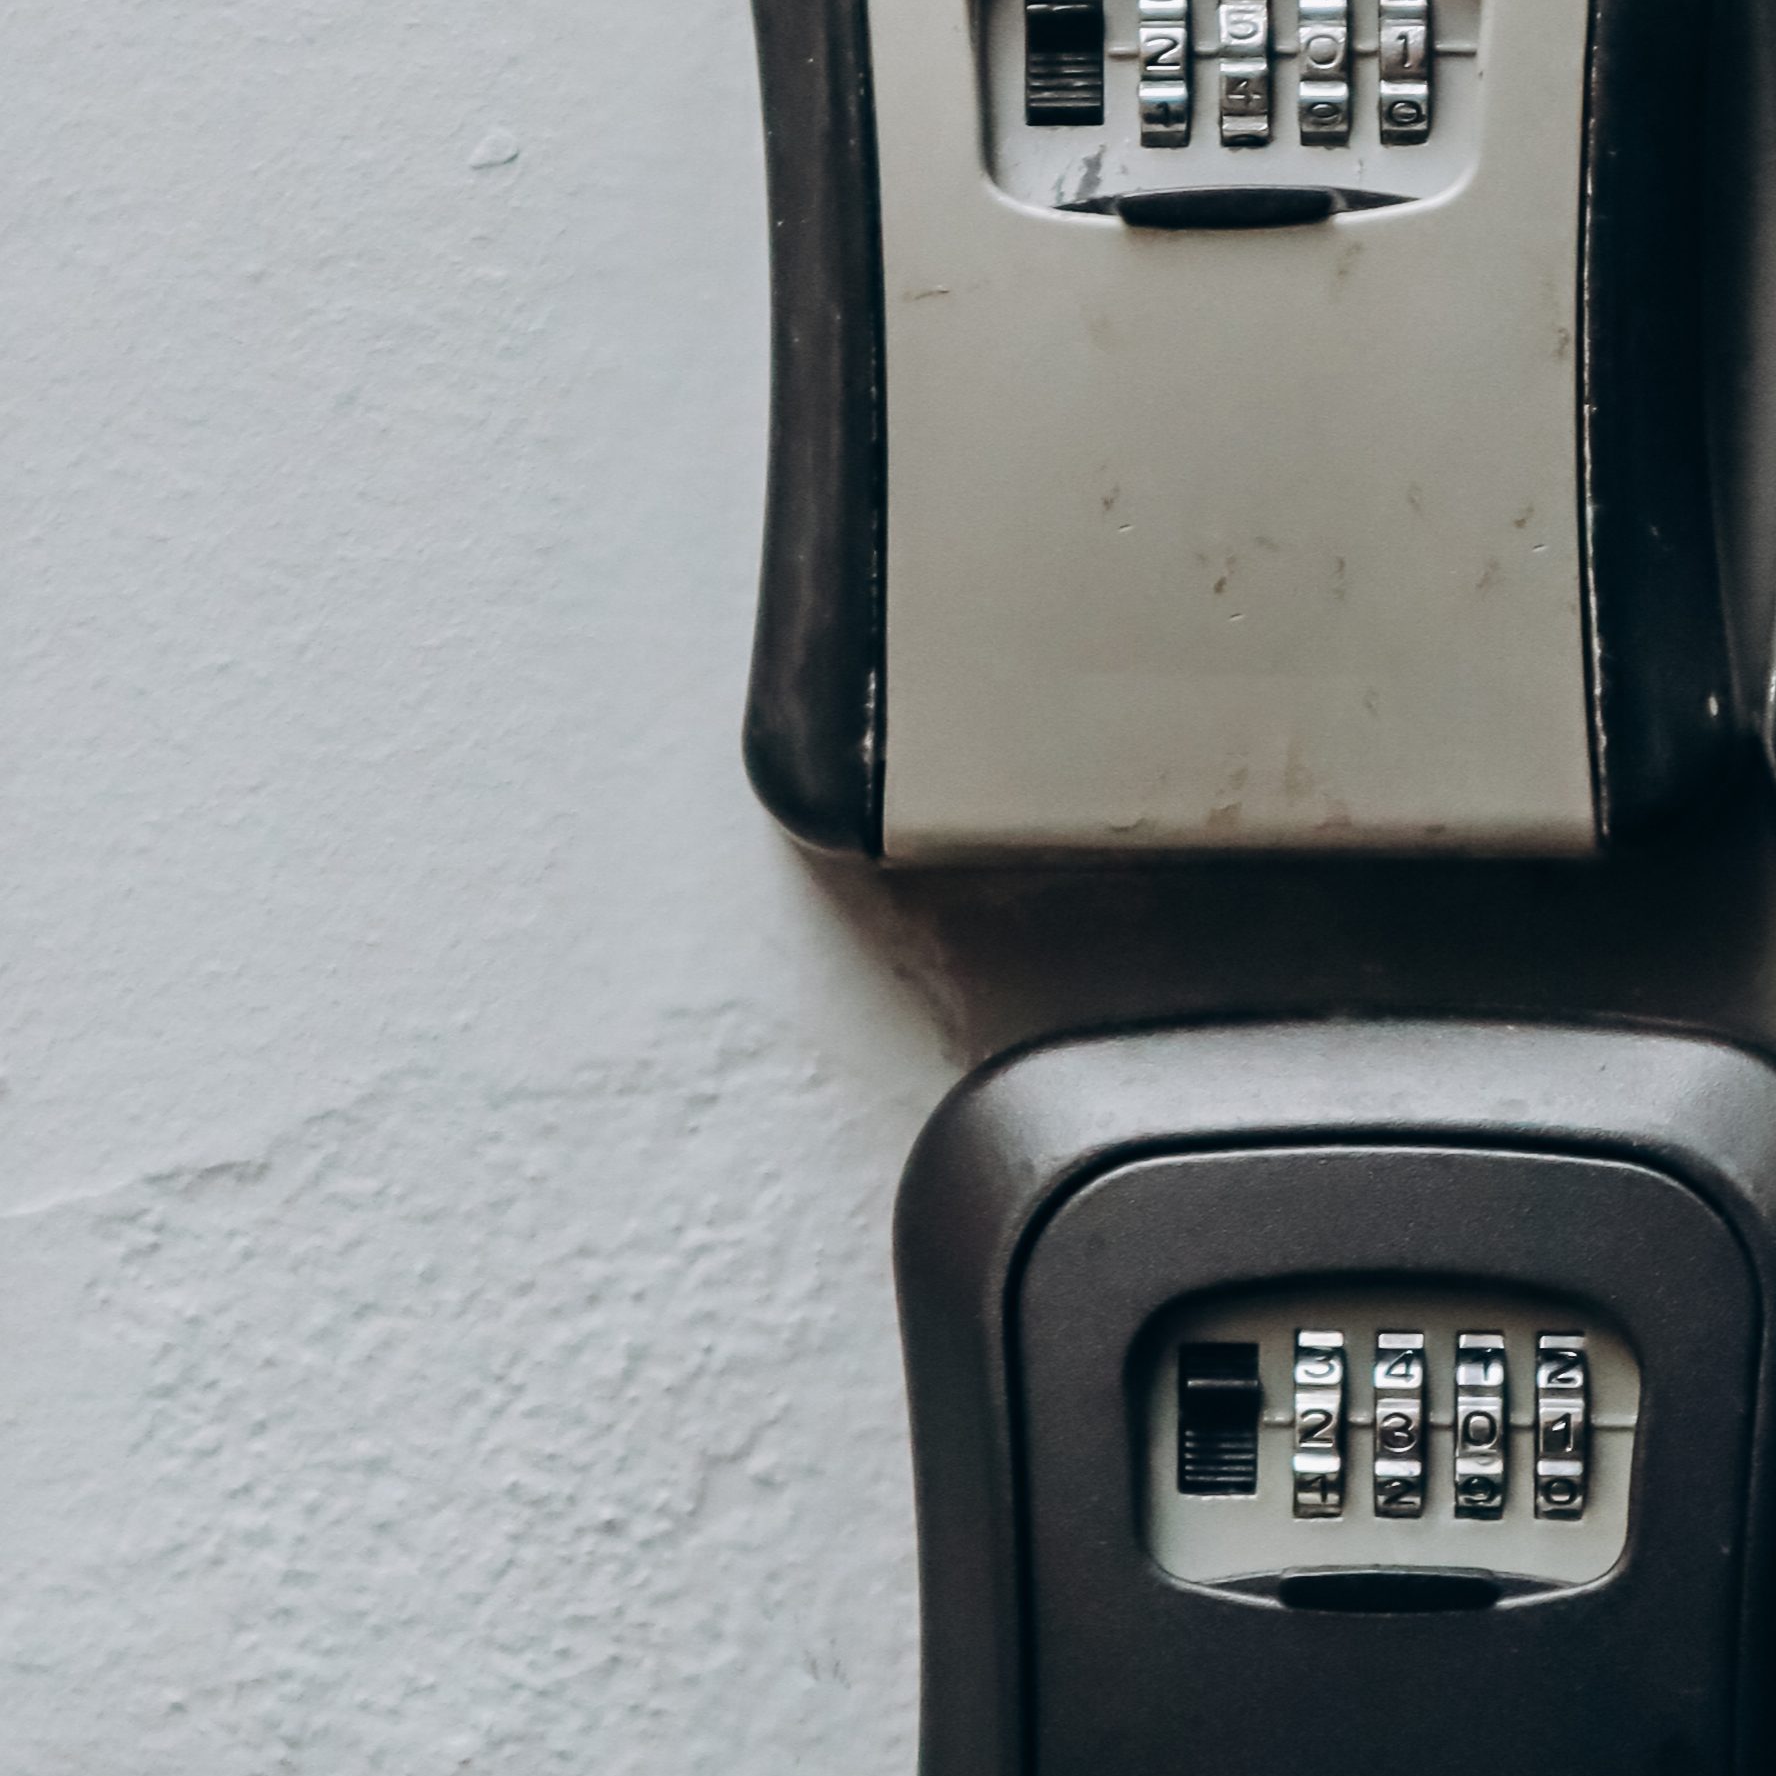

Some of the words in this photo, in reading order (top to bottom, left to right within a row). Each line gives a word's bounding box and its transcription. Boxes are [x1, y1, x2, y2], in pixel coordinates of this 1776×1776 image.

[1144, 36, 1181, 70] 2
[1228, 9, 1259, 39] 5
[1306, 34, 1344, 70] 0
[1396, 31, 1412, 68] 1
[1228, 80, 1262, 105] 4
[1302, 1347, 1336, 1378] 3
[1384, 1349, 1416, 1383] 4
[1546, 1349, 1582, 1383] 2
[1299, 1408, 1334, 1447] 2
[1381, 1411, 1418, 1452] 3
[1461, 1410, 1498, 1451] 0
[1551, 1412, 1574, 1452] 1
[1383, 1477, 1416, 1506] 2
[1543, 1477, 1579, 1505] 0
